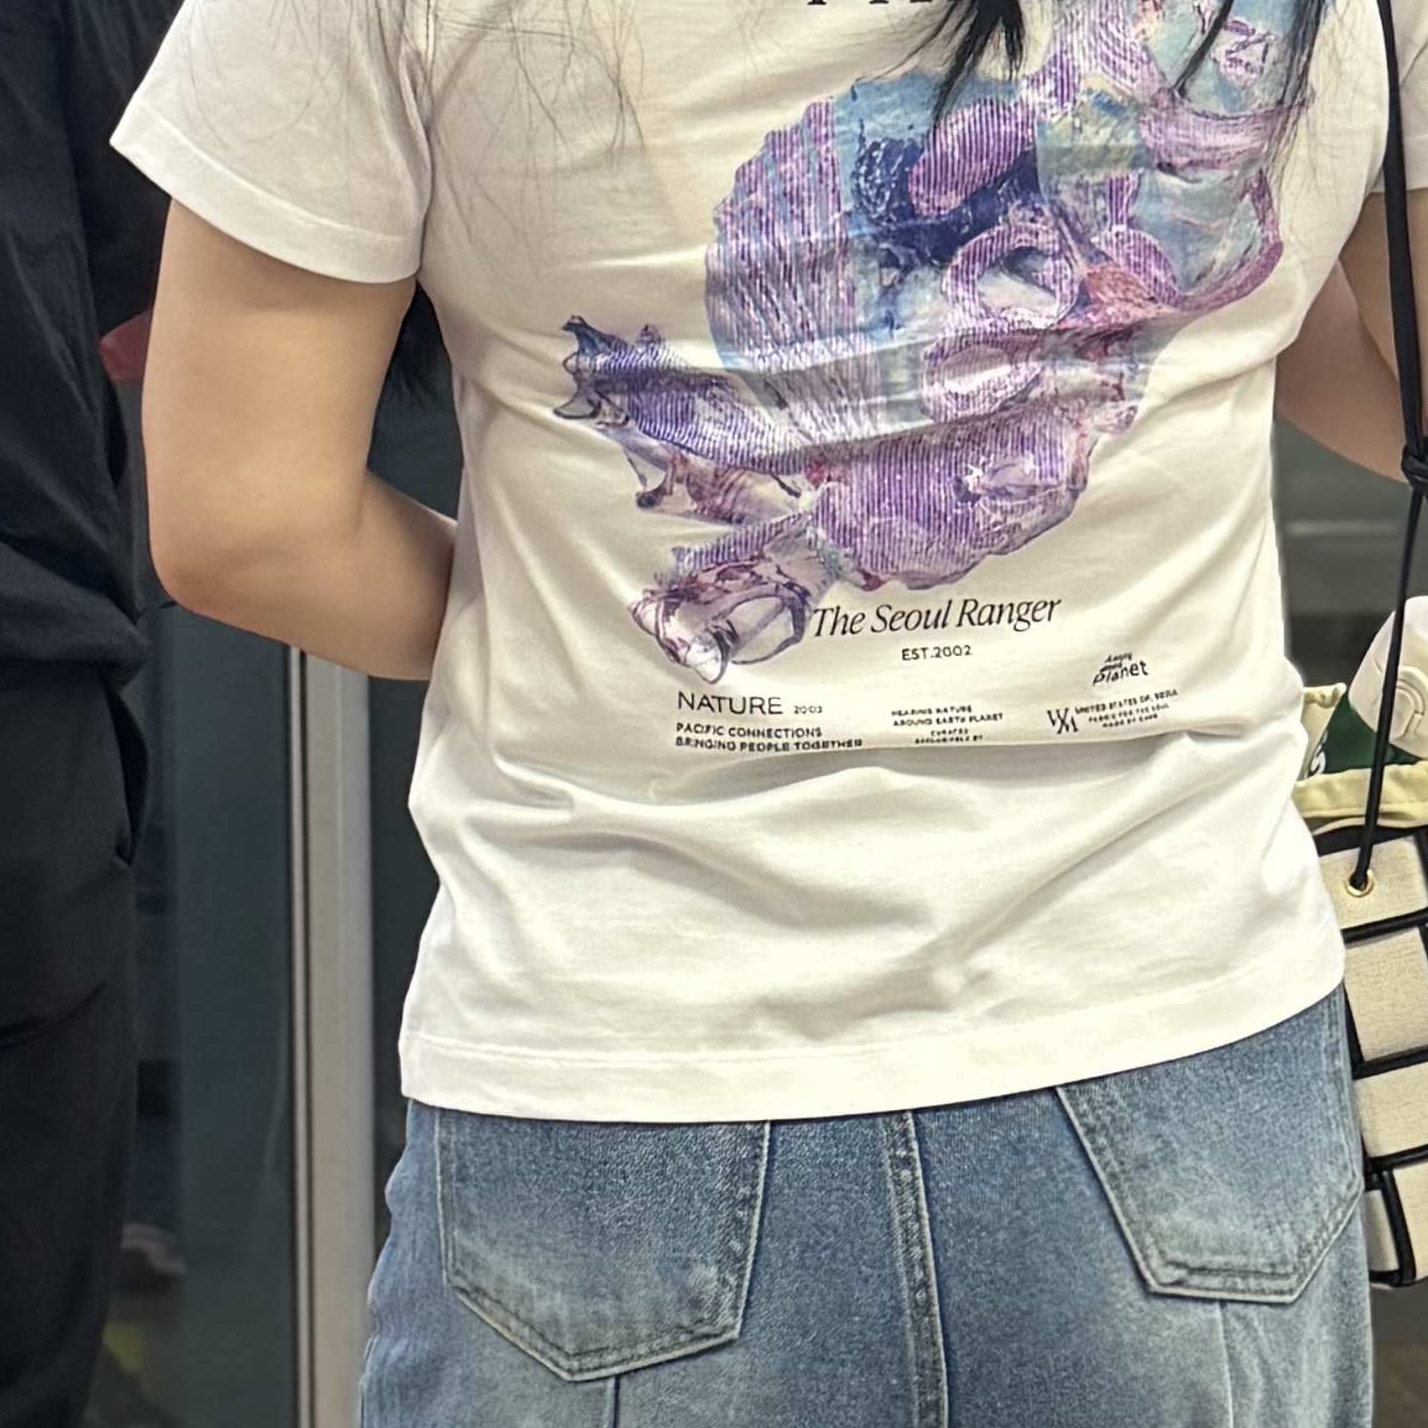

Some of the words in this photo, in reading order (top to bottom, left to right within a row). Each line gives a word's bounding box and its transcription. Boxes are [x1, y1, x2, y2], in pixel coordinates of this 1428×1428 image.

[813, 605, 866, 637] The
[871, 599, 953, 633] Seoul
[956, 598, 1062, 632] Ranger
[901, 644, 973, 661] EST.2002
[677, 691, 783, 715] NATURE
[676, 722, 725, 737] PACIFIC
[728, 726, 823, 739] CONNECTIONS
[739, 740, 790, 752] PEOPLE
[793, 738, 863, 751] TOGETHER
